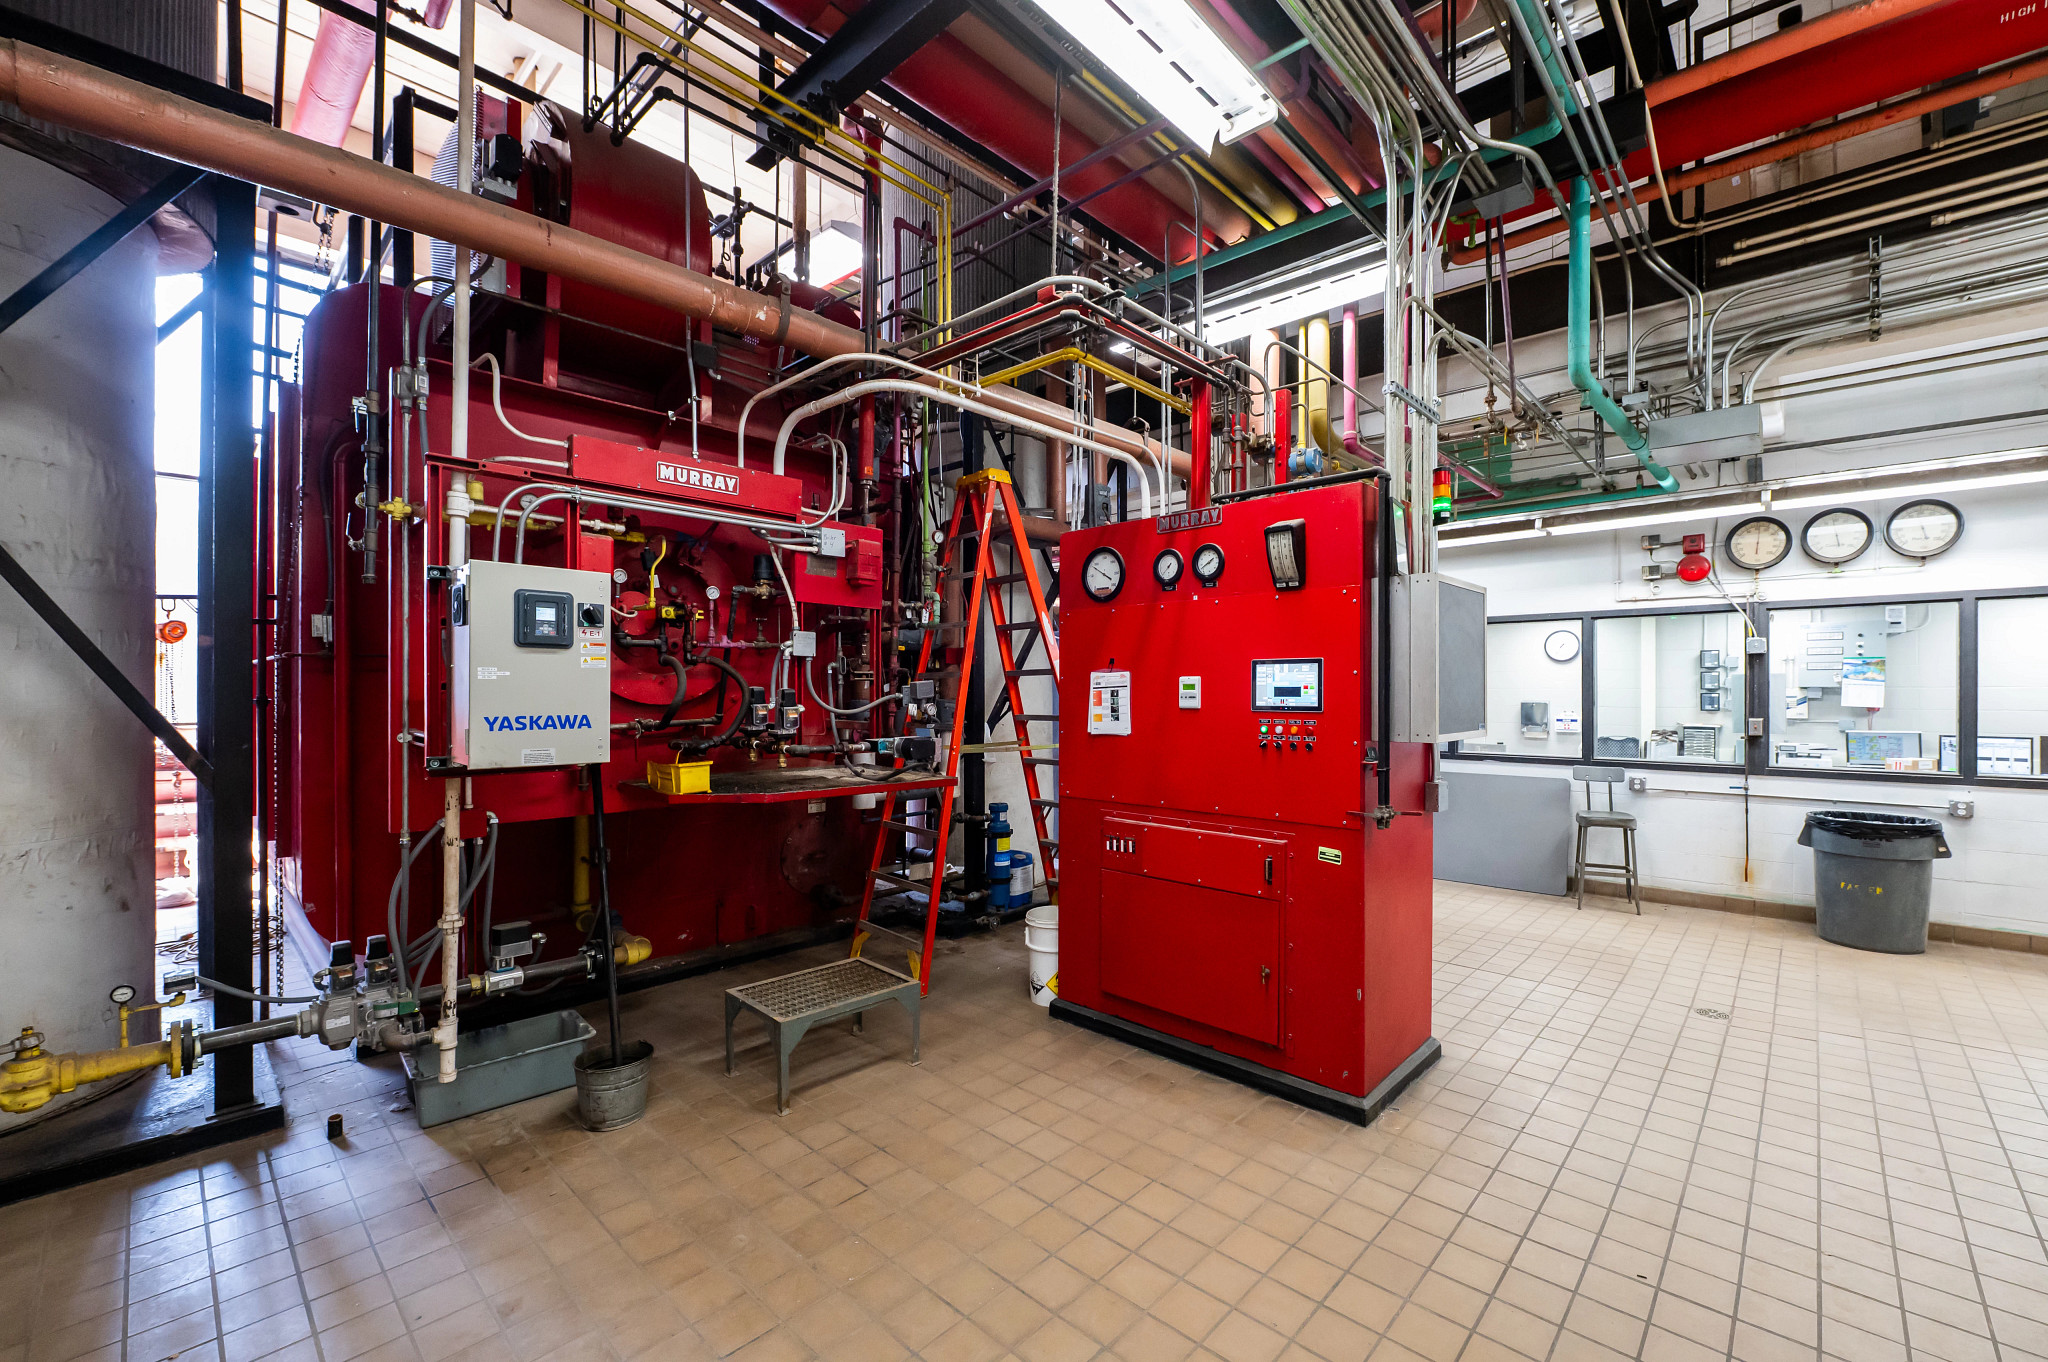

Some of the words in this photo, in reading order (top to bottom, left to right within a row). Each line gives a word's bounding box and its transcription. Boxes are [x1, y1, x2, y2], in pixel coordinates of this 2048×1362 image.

[2000, 2, 2037, 24] HIGH
[659, 464, 737, 492] MURRAY
[1158, 508, 1220, 531] MURRAY
[483, 714, 592, 732] YASKAWA
